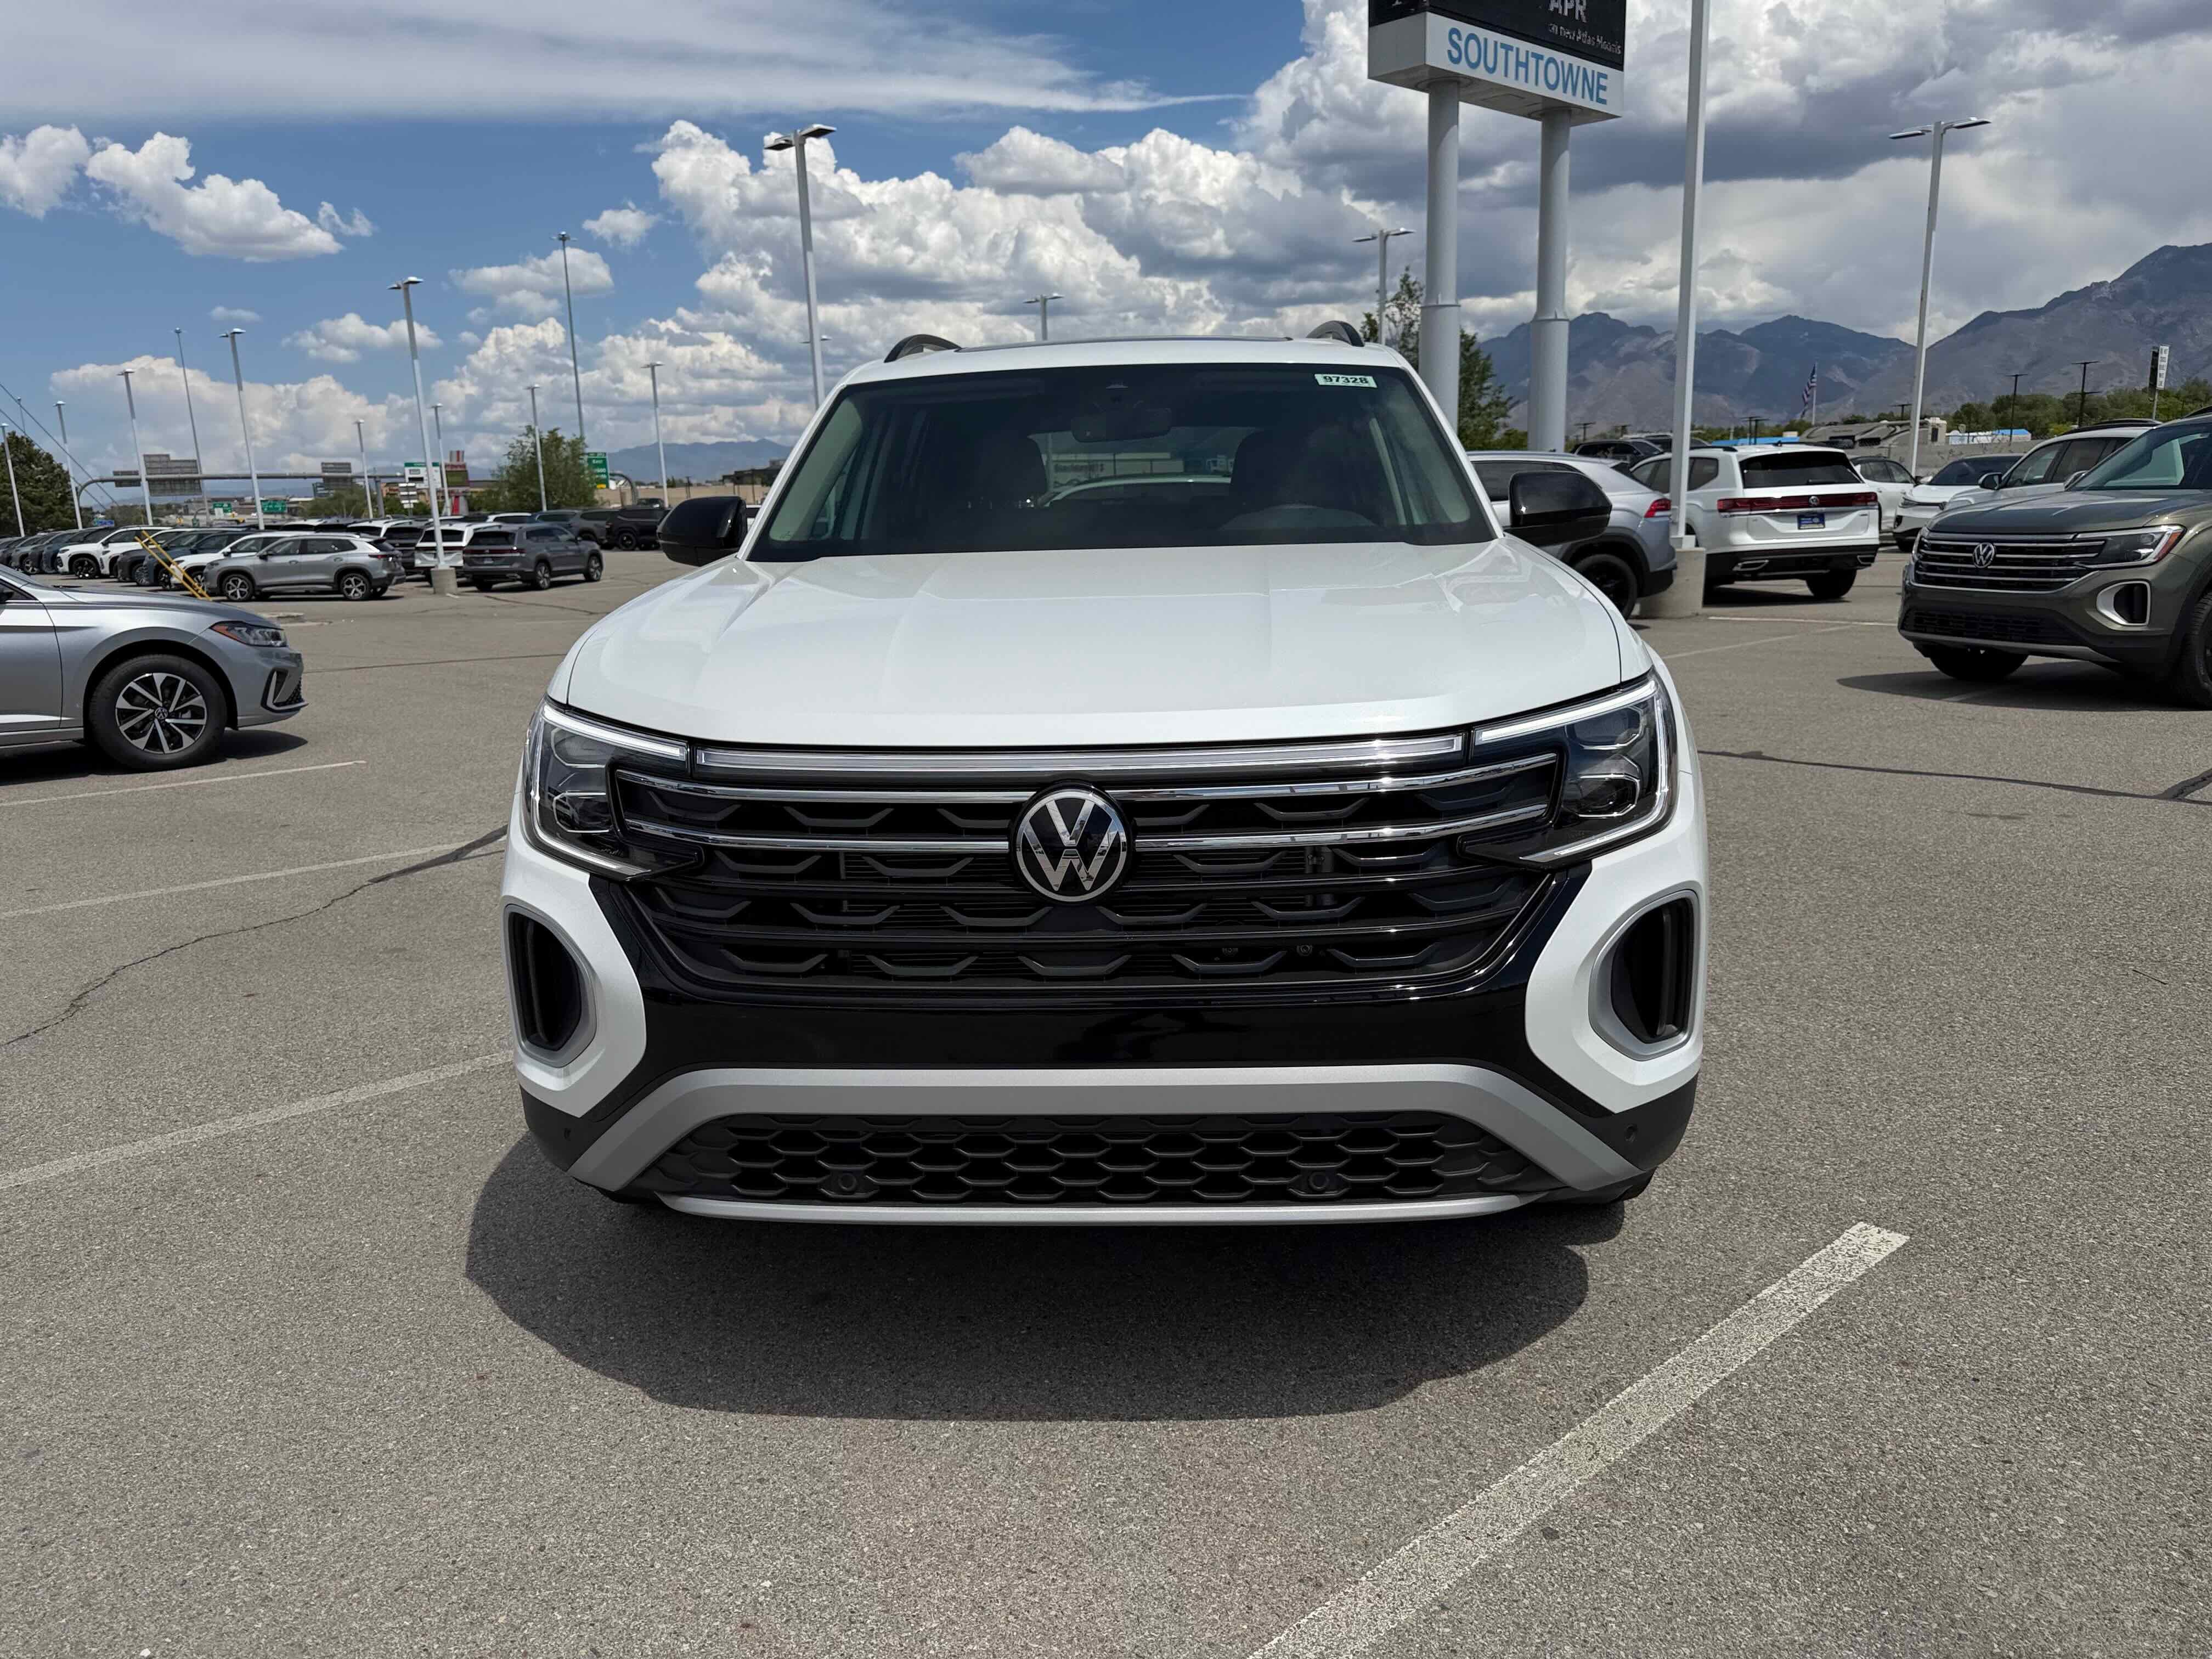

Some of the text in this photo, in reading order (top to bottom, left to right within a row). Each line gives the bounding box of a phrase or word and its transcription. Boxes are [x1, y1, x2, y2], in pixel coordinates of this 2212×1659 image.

[1447, 27, 1608, 105] SOUTHTOWNE
[1323, 376, 1369, 384] 97328
[1017, 788, 1127, 902] VW
